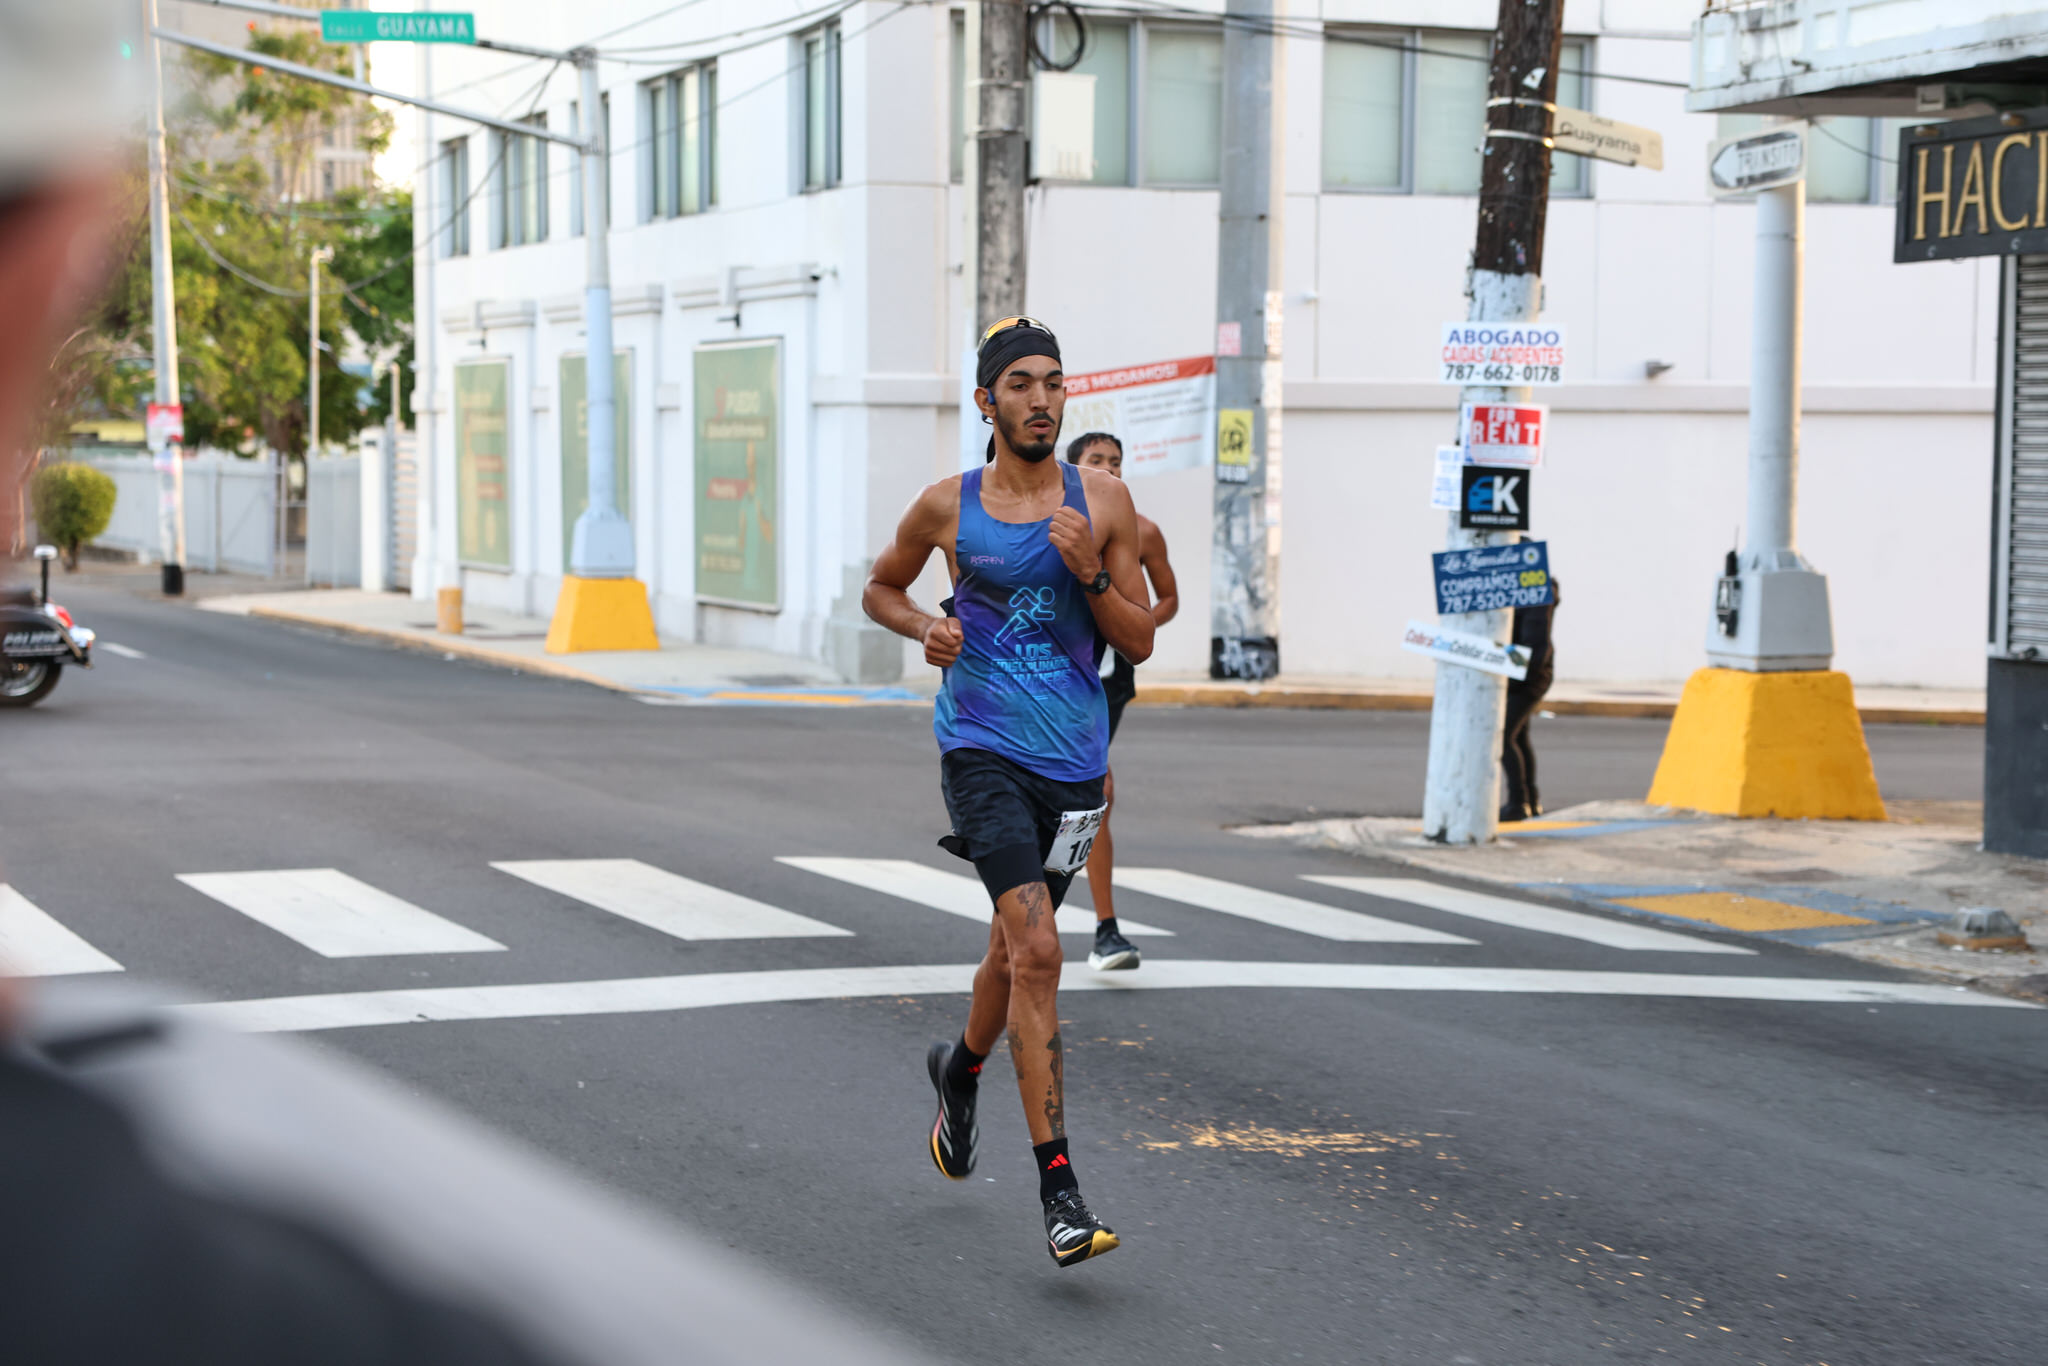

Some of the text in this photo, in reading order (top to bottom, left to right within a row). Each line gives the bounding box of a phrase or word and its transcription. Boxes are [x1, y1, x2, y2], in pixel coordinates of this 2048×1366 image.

[377, 15, 469, 38] GUAYAMA
[1560, 121, 1642, 155] Guayama
[1738, 141, 1799, 177] TRANSITO
[1913, 130, 2048, 241] HACI
[1448, 329, 1560, 346] ABOGADO
[1446, 364, 1560, 382] 787-662-0178
[1488, 407, 1516, 422] FOR
[1471, 421, 1540, 446] RENT
[1492, 475, 1521, 514] K
[1440, 570, 1548, 597] COMPRAMOS ORO
[1015, 643, 1054, 660] LOS
